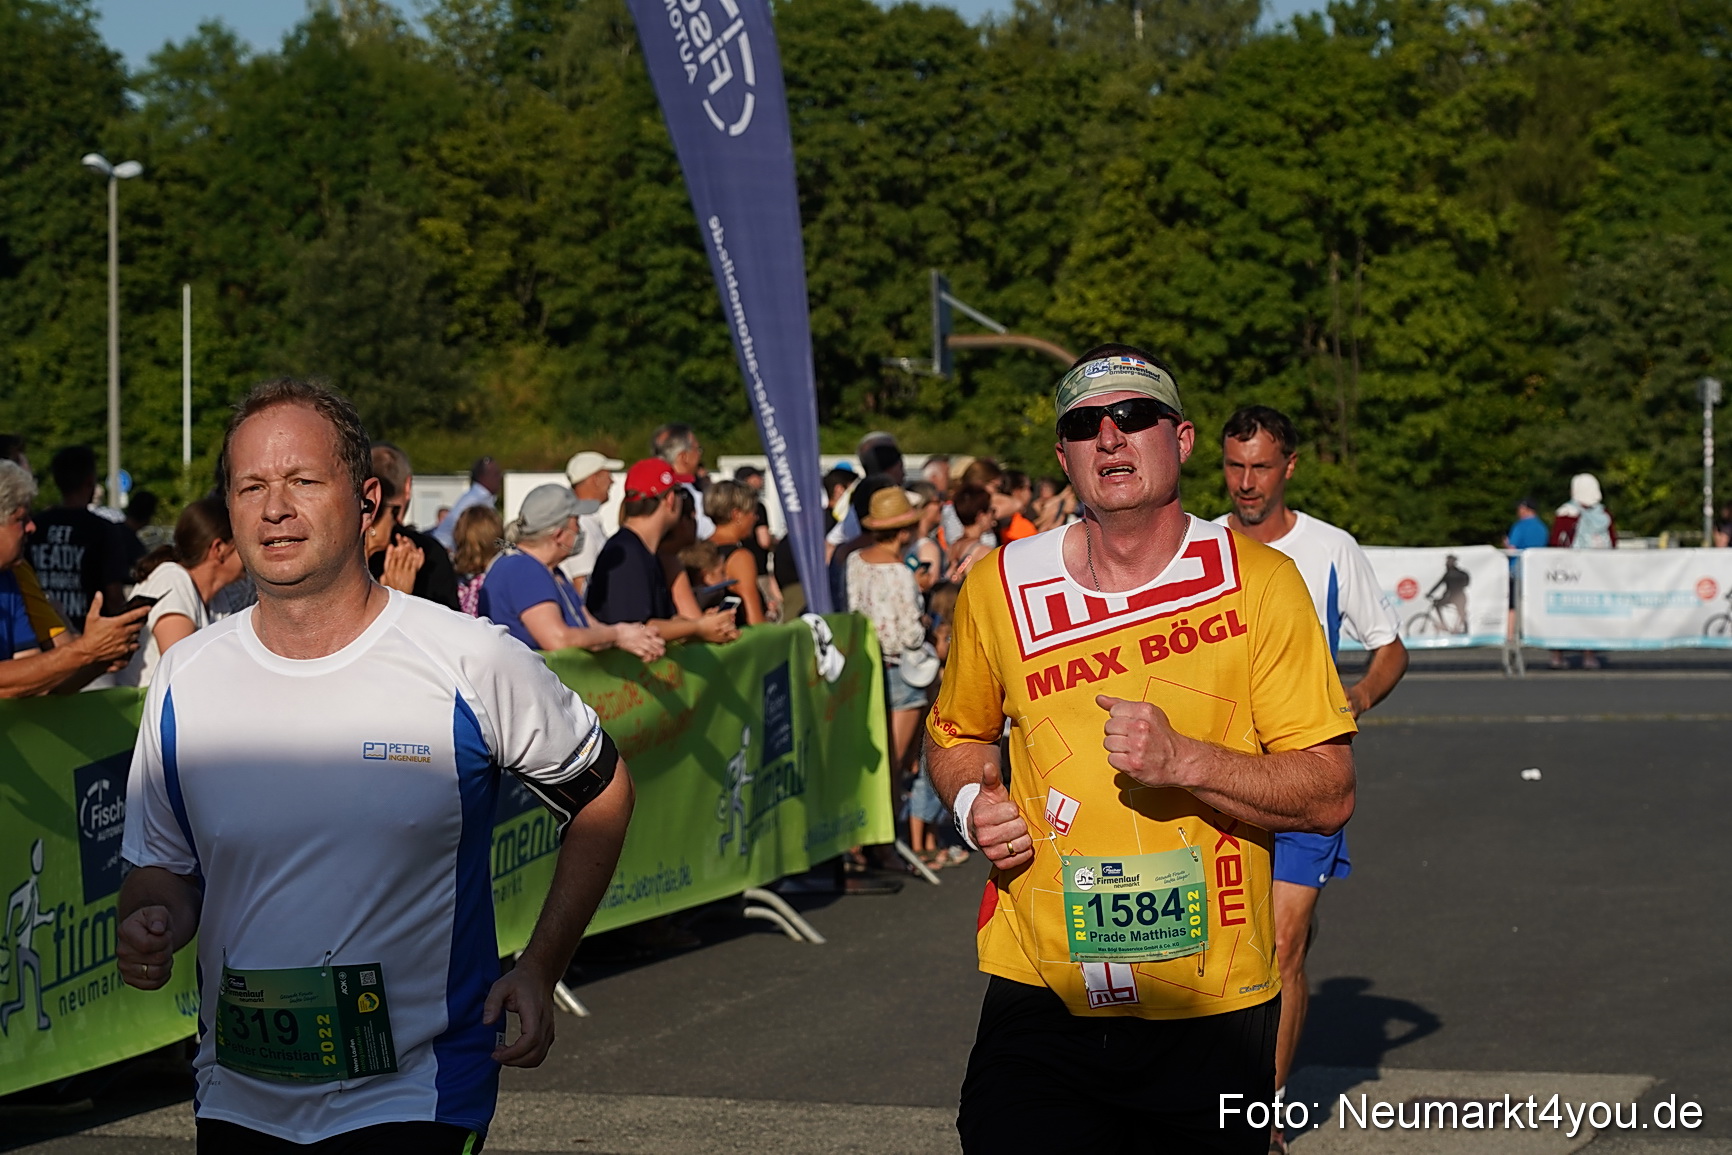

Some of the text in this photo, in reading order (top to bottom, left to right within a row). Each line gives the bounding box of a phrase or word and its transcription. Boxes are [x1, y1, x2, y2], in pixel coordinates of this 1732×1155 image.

[1025, 609, 1248, 702] MAX BÖGL
[389, 743, 431, 755] PETTER
[389, 754, 431, 763] INGENIEURE
[1096, 874, 1140, 885] Firmenlauf
[1087, 887, 1186, 928] 1584
[1187, 889, 1202, 939] 2022
[1073, 905, 1087, 941] RUN
[1090, 927, 1187, 943] Prade Matthias
[340, 980, 348, 995] AOK
[228, 1005, 299, 1046] 319
[225, 1039, 320, 1061] Petter Christian
[316, 1013, 337, 1066] 2022
[349, 1038, 358, 1058] Laufen
